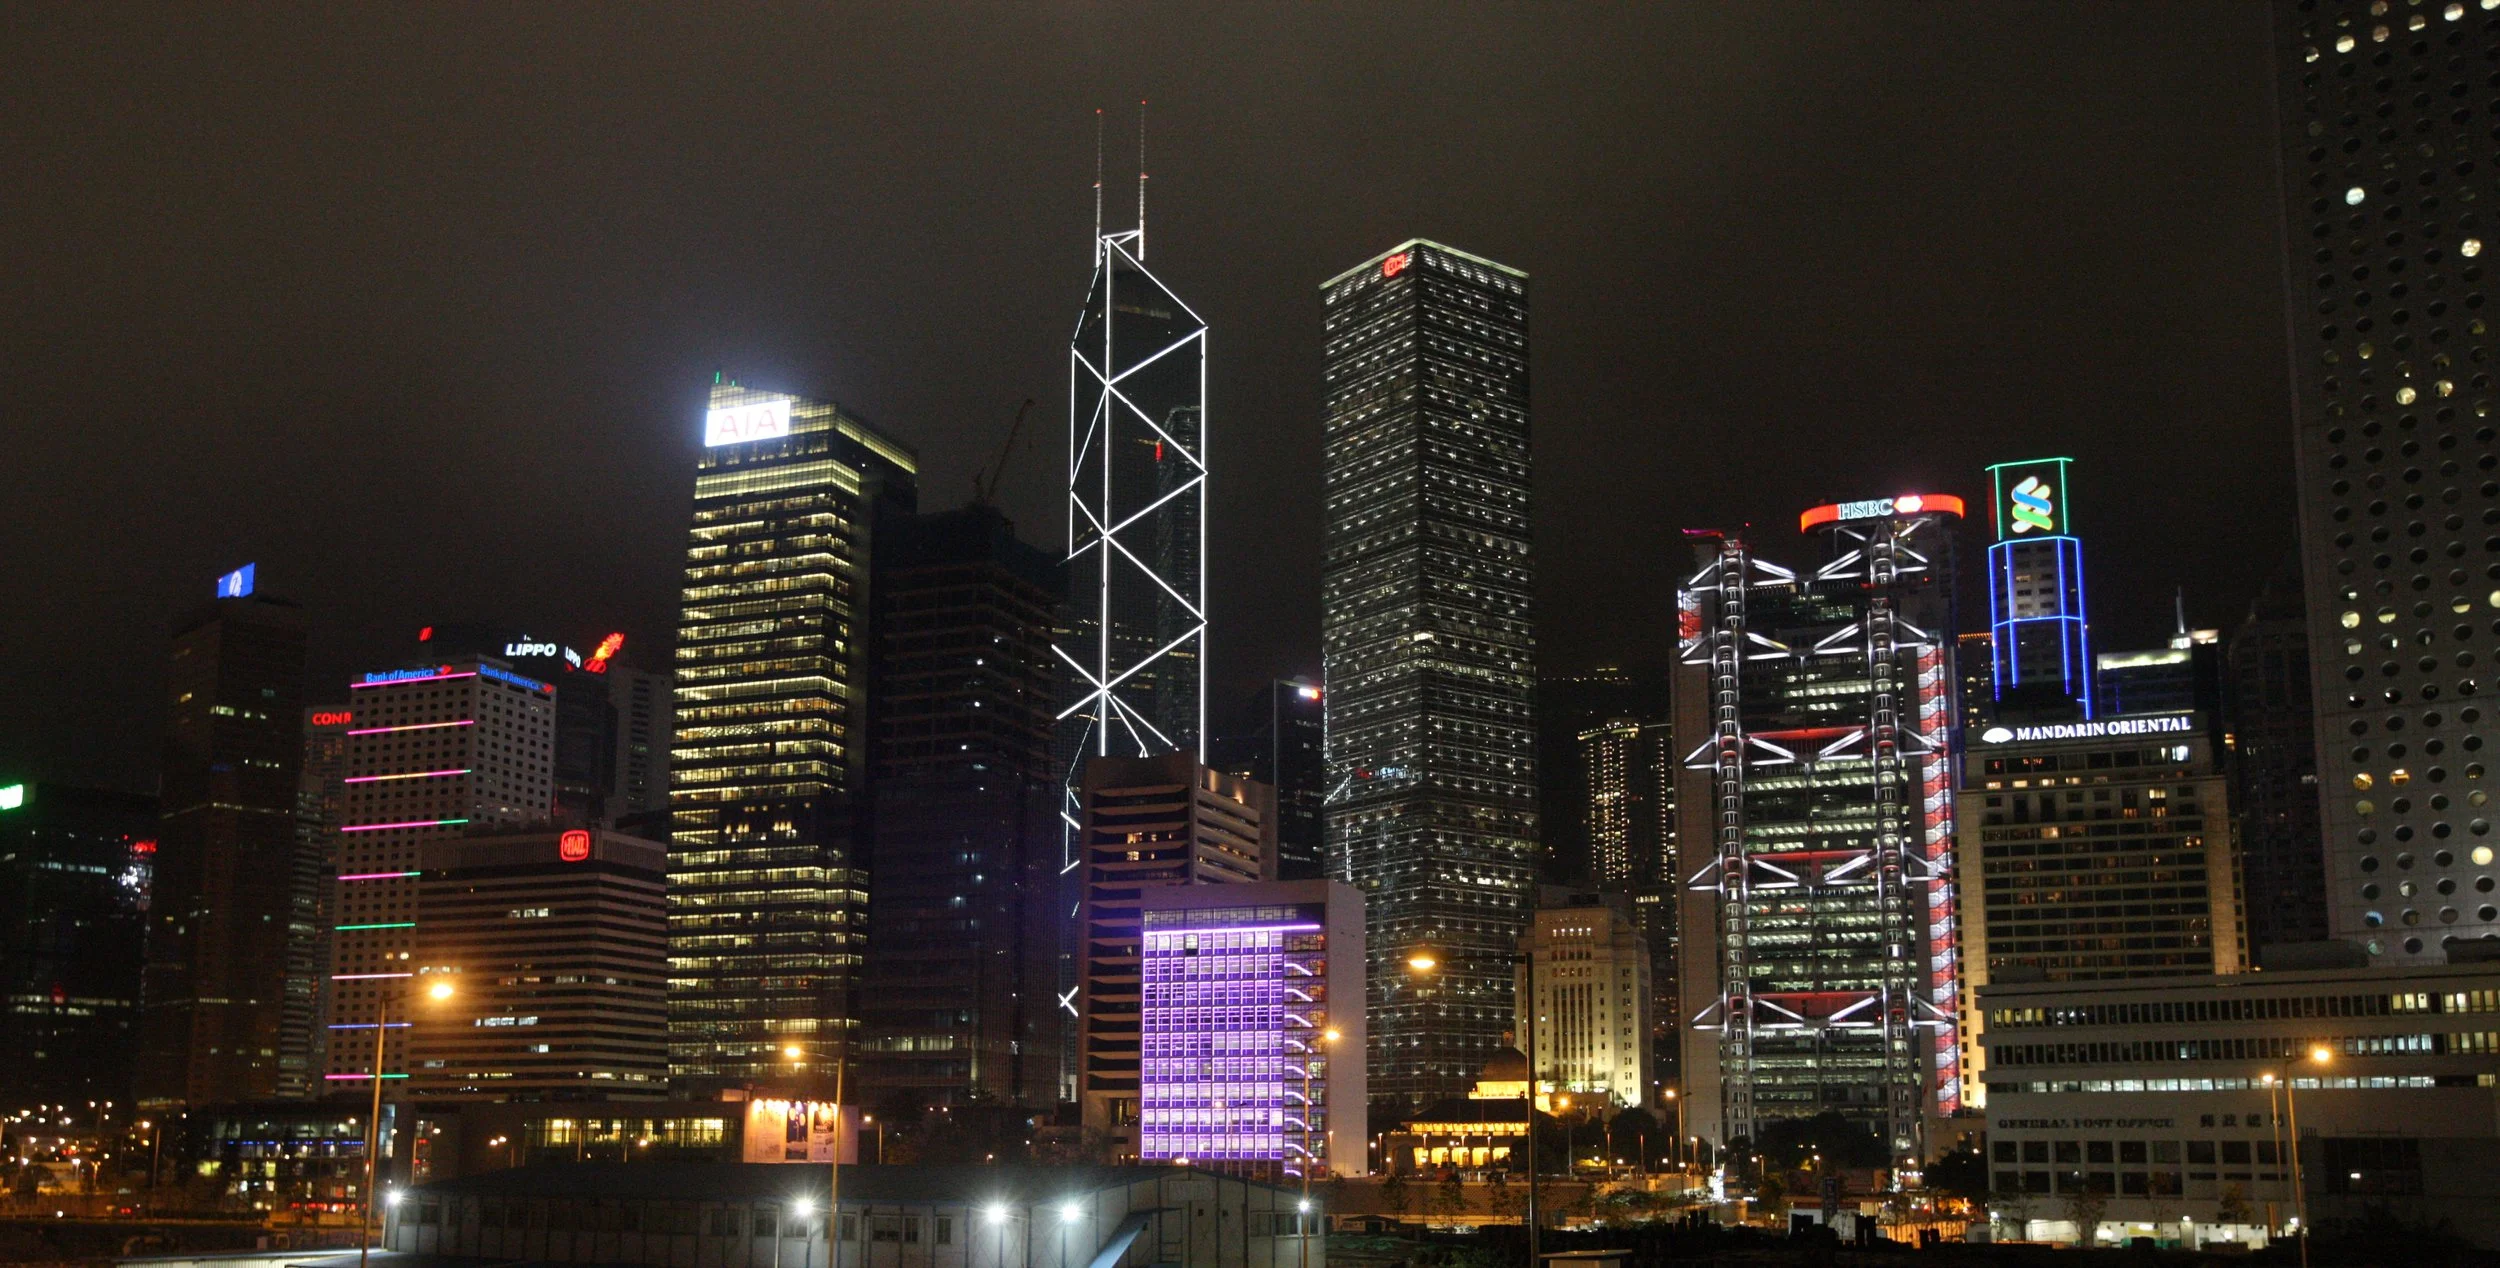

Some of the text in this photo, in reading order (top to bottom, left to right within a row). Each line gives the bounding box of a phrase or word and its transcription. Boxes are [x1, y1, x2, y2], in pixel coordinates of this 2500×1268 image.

[716, 408, 778, 441] AIA
[1837, 499, 1894, 520] HSBC
[505, 643, 557, 657] LIPPO
[366, 667, 435, 683] Bank of America
[480, 663, 499, 679] Bank
[509, 673, 540, 690] America
[2016, 716, 2192, 742] MANDARIN ORIENTAL
[1997, 1117, 2175, 1130] GENERAL POST OFFICE
